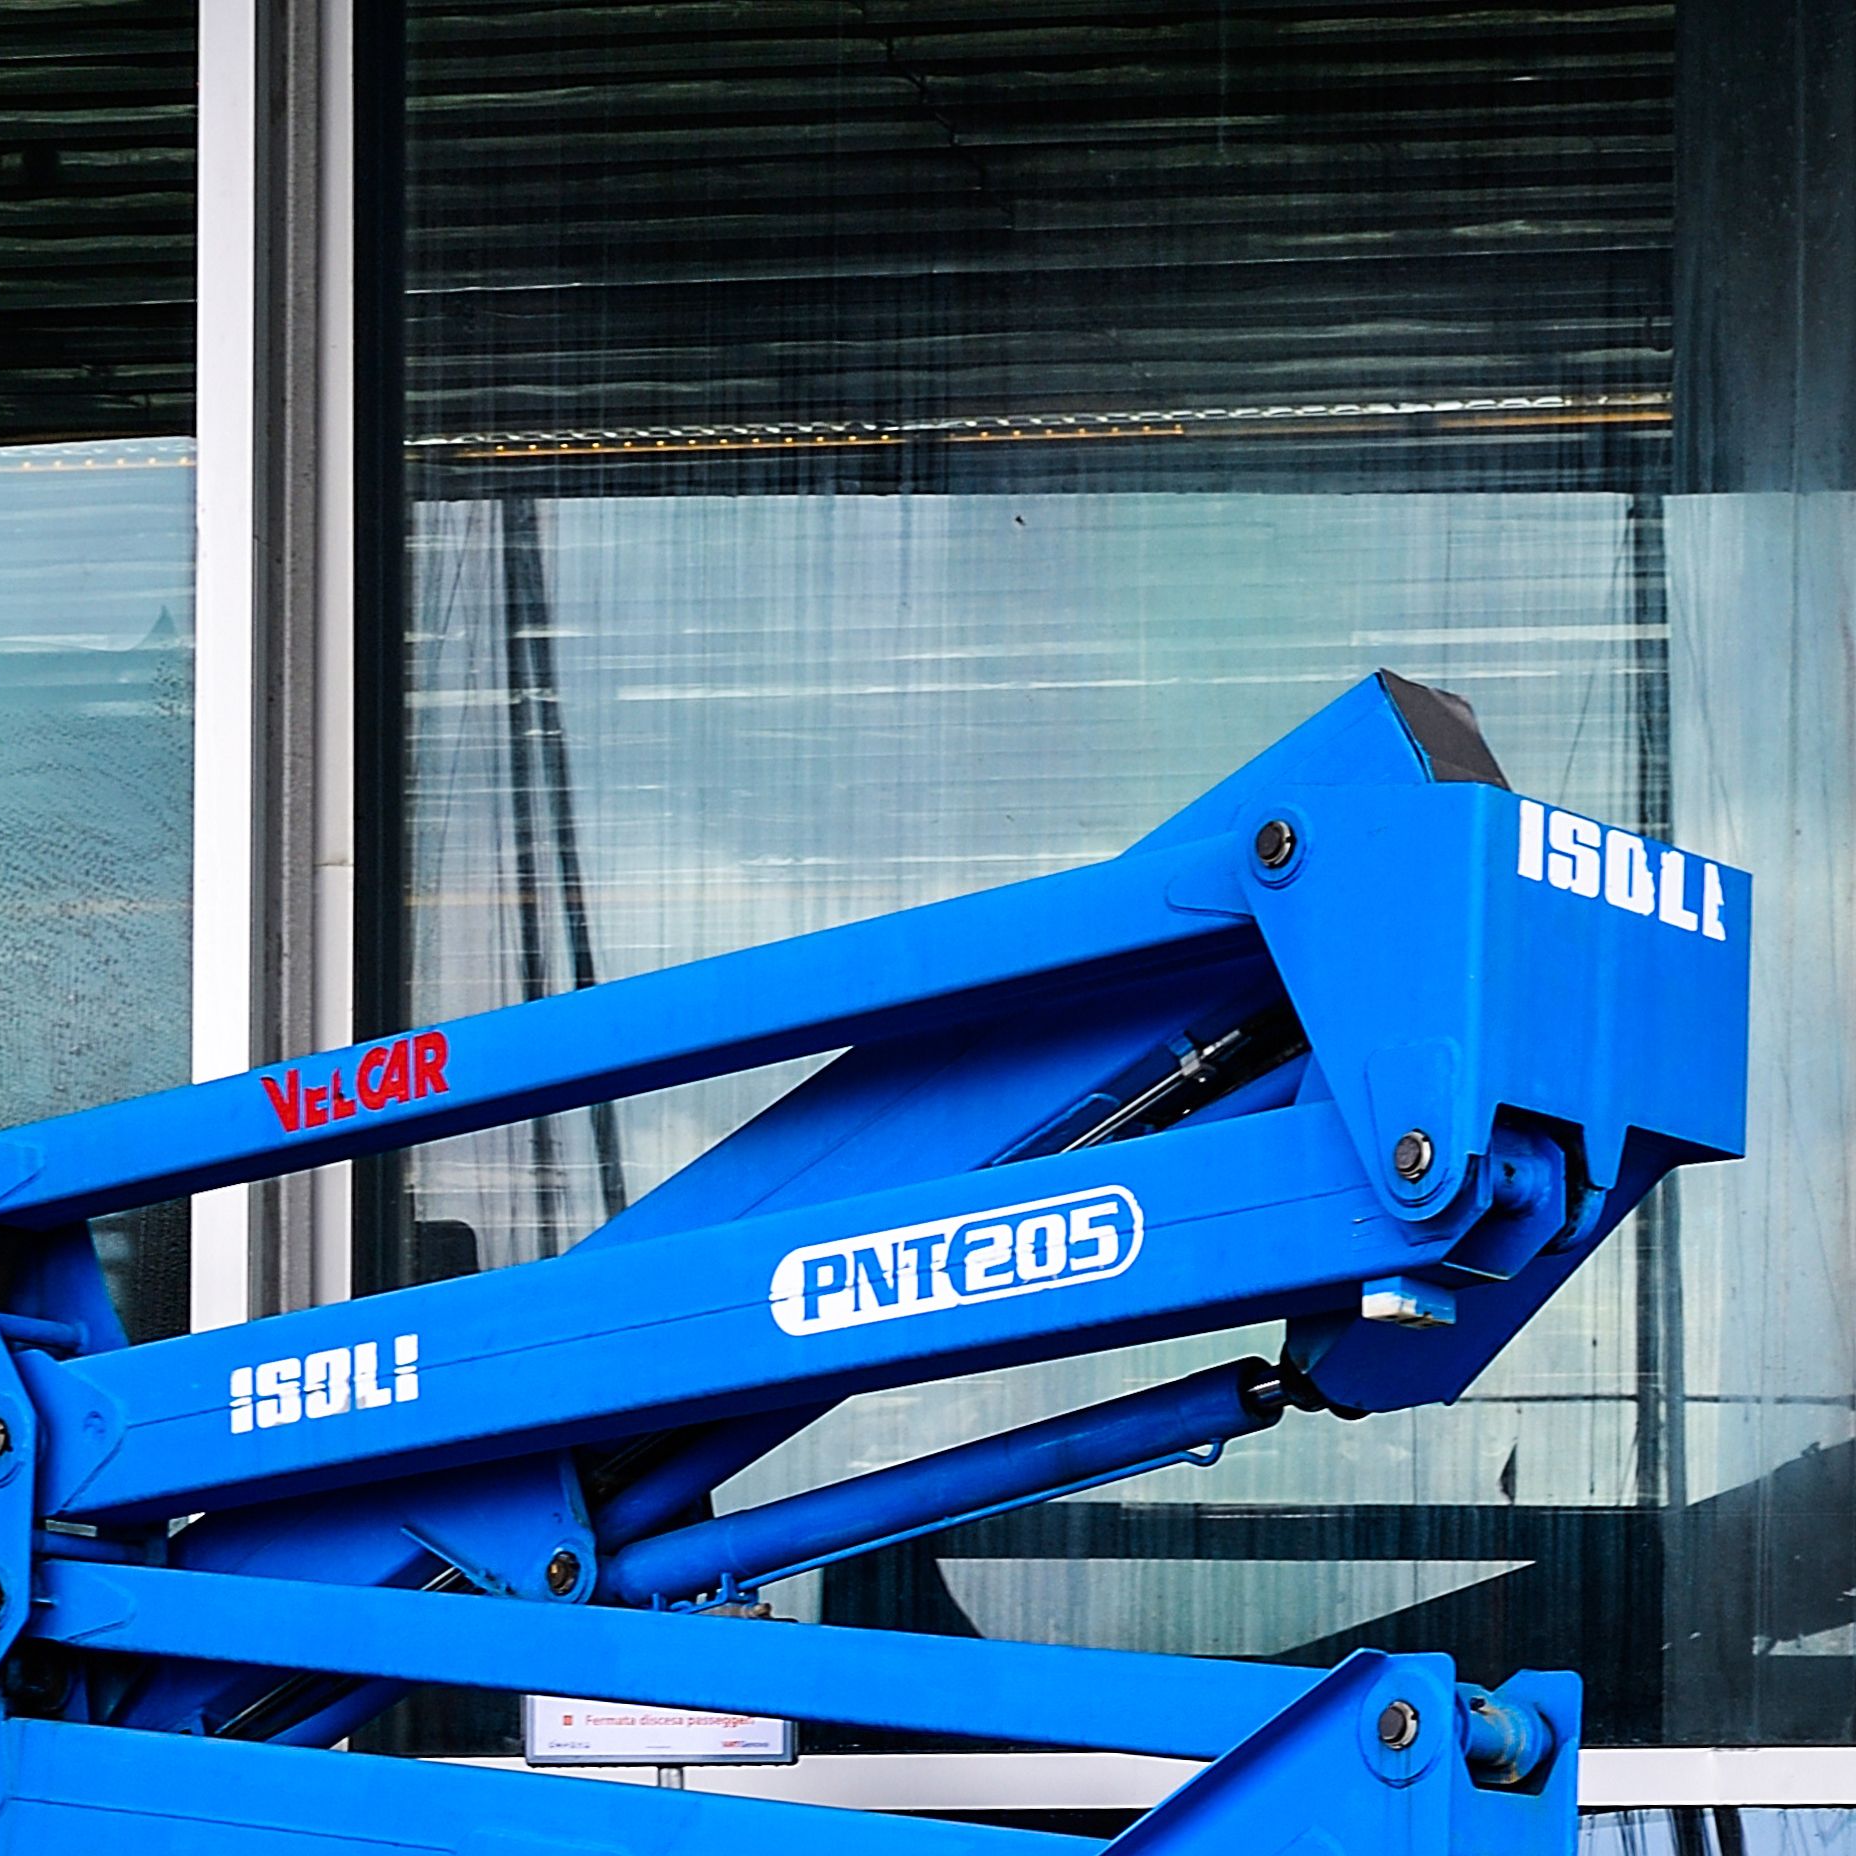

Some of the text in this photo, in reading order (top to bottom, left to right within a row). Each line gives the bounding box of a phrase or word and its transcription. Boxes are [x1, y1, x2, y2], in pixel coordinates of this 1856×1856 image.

[1517, 799, 1726, 941] ISOLI
[262, 1033, 449, 1132] VELCAR
[229, 1335, 419, 1434] ISOLI
